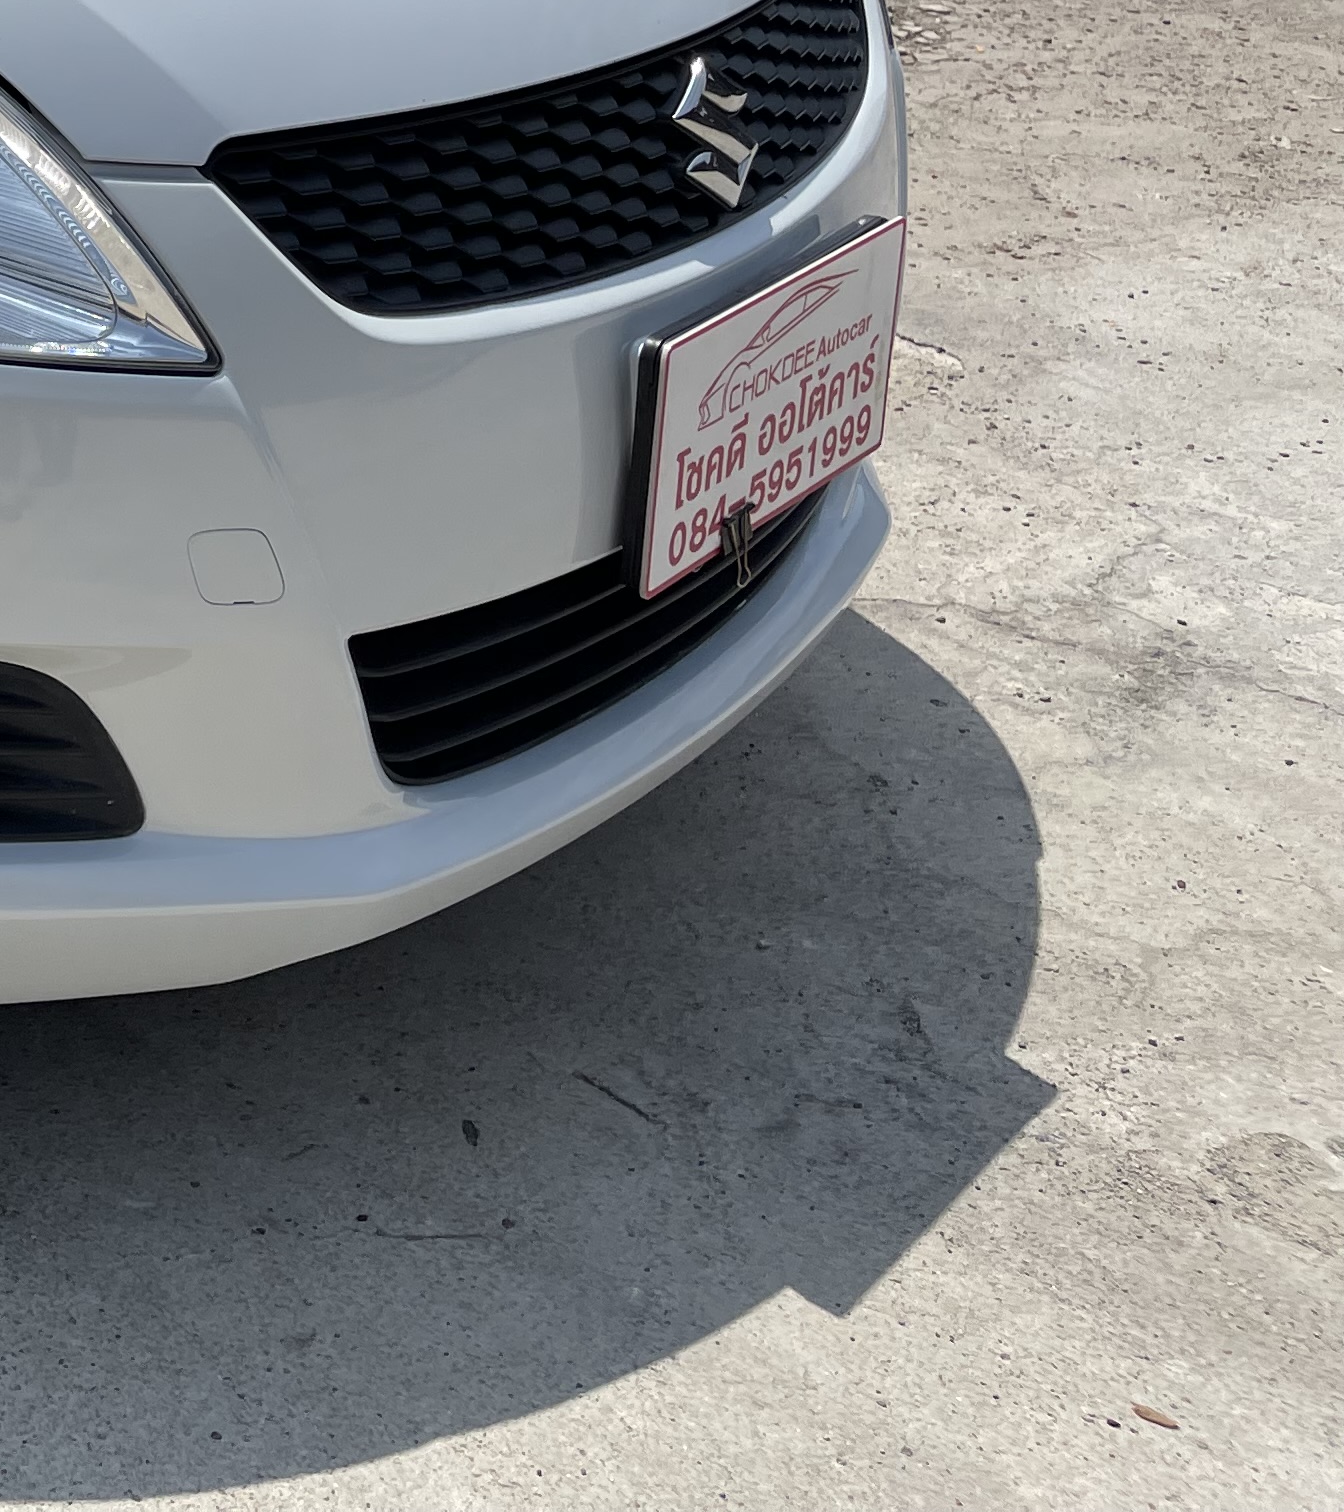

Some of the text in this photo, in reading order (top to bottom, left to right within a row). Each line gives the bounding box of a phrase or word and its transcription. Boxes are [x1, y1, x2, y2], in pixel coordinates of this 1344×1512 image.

[674, 334, 879, 510] โชคดี ออโต้คาร์
[728, 314, 873, 414] CHOKDEE Autocar
[668, 404, 872, 567] 084-5951999
